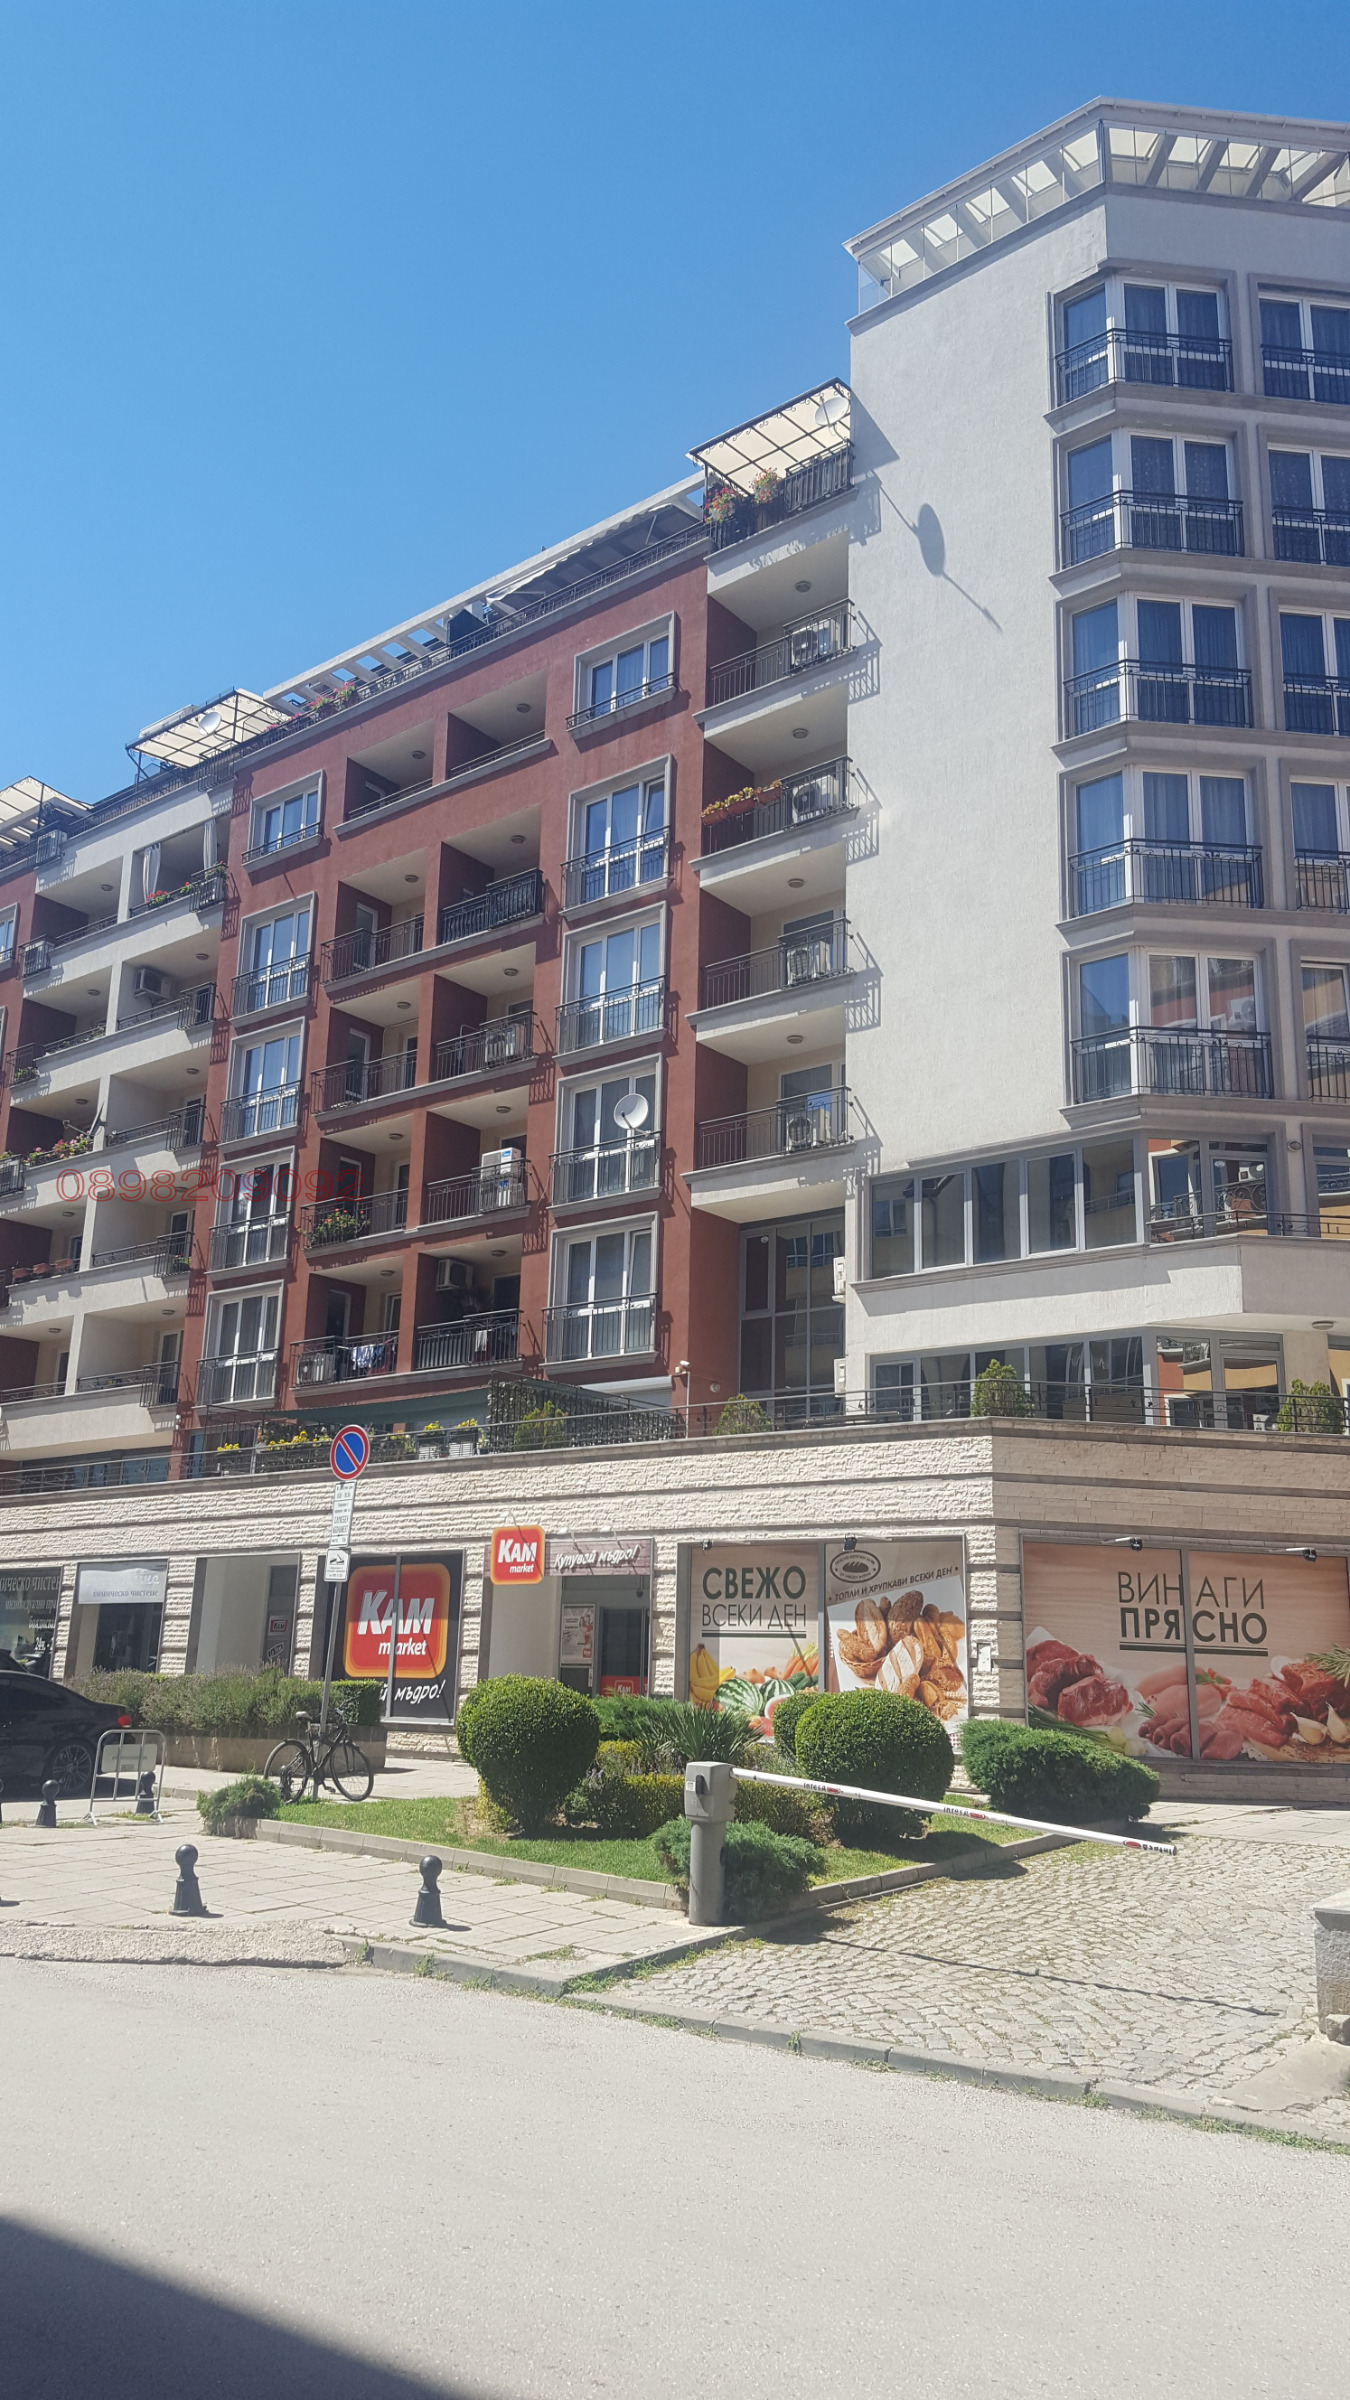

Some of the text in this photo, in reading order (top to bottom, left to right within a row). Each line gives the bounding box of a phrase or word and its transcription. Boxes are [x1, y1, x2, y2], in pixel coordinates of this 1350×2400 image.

[509, 1563, 535, 1574] market
[553, 1544, 640, 1571] Купувай мъдро!
[0, 1576, 30, 1592] ическо
[702, 1566, 806, 1600] СВЕЖО
[835, 1566, 953, 1601] ТОПЛИ И ХРУПКАВИ ВСЕКИ ДЕН
[1117, 1571, 1265, 1610] ВИНАГИ
[702, 1604, 806, 1630] ВСЕКИ ДЕН
[1120, 1607, 1268, 1645] ПРЯСНО
[378, 1637, 427, 1655] market
[394, 1679, 446, 1704] мъдро!
